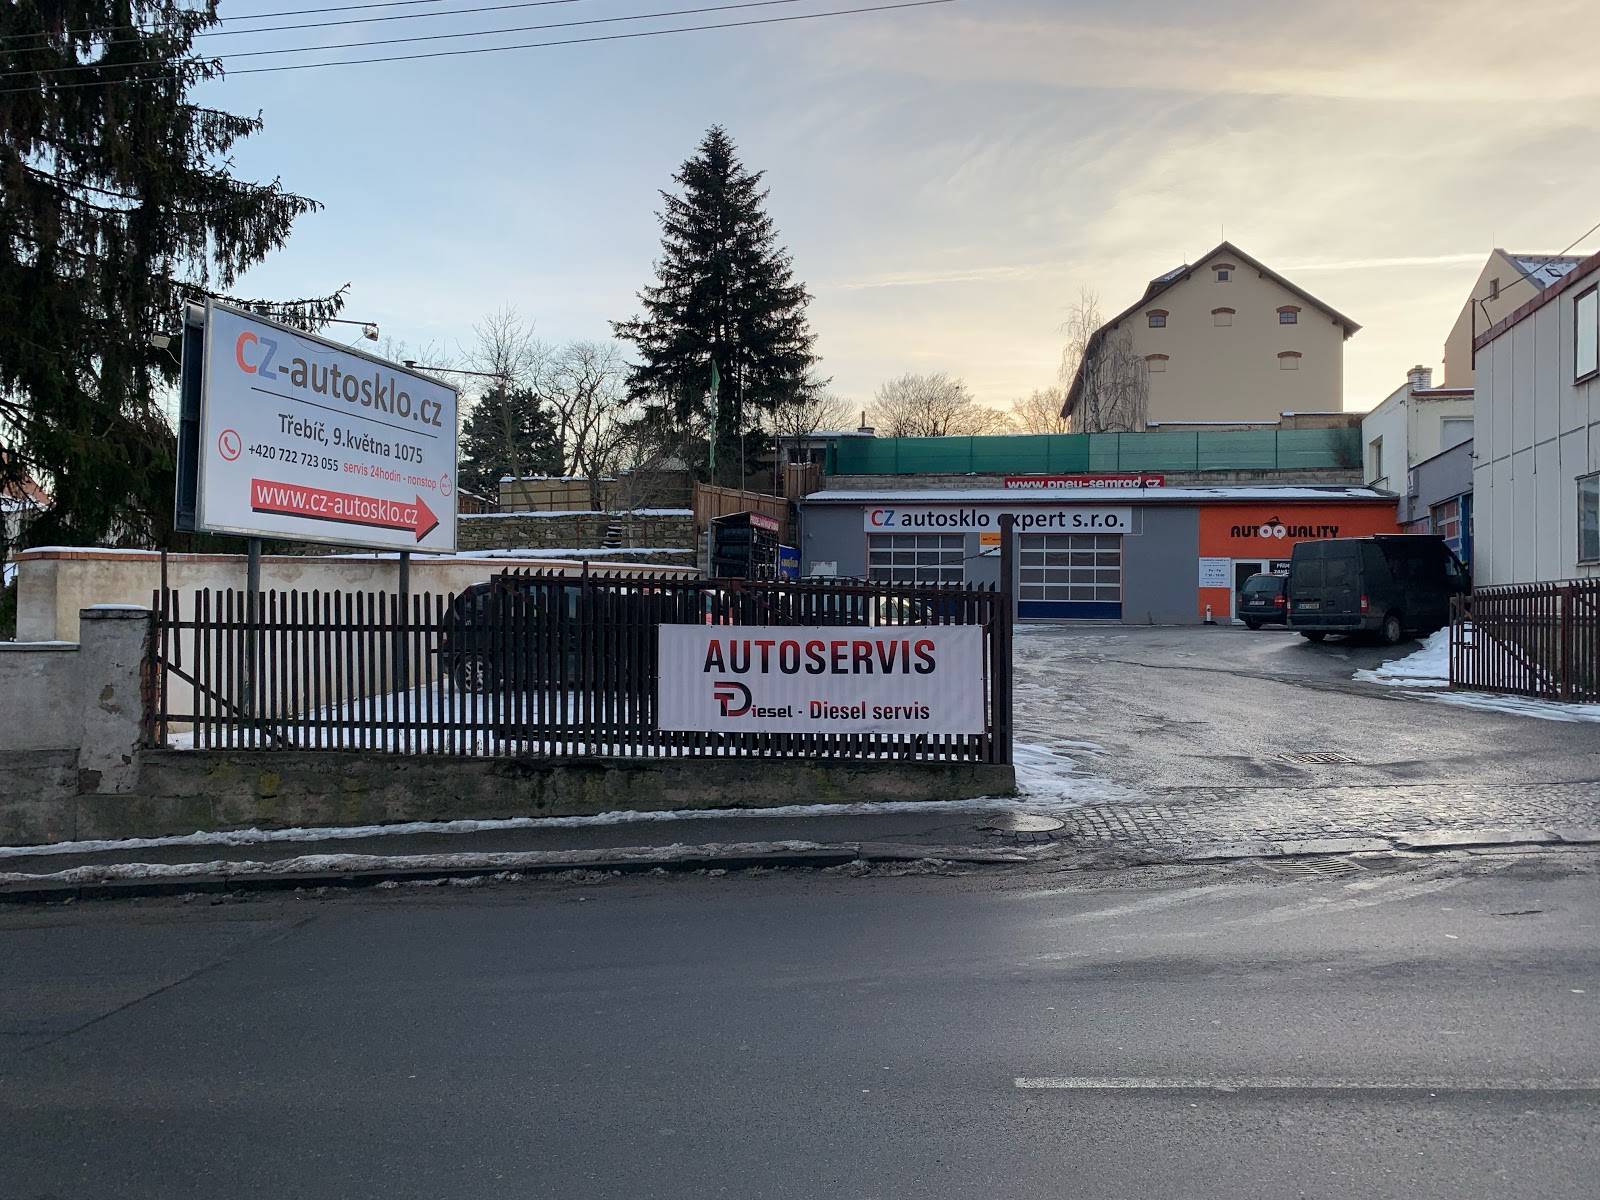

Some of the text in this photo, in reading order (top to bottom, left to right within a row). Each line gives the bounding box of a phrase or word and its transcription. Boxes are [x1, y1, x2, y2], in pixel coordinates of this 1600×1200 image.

[235, 331, 442, 427] CZ-autosklo.cz
[278, 413, 423, 464] Třebíč, 9.května 1075
[248, 444, 276, 460] +420
[278, 448, 298, 464] 722
[301, 452, 319, 468] 723
[321, 457, 339, 472] 055
[343, 462, 368, 477] servis
[370, 465, 401, 483] 24hodin
[407, 474, 437, 491] nonstop
[256, 484, 418, 525] www.cz-autosklo.cz
[871, 510, 895, 526] CZ
[901, 509, 990, 528] autosklo
[1072, 514, 1124, 528] s.r.o.
[703, 639, 937, 675] AUTOSERVIS
[810, 701, 866, 720] Diesel
[872, 702, 930, 720] servis
